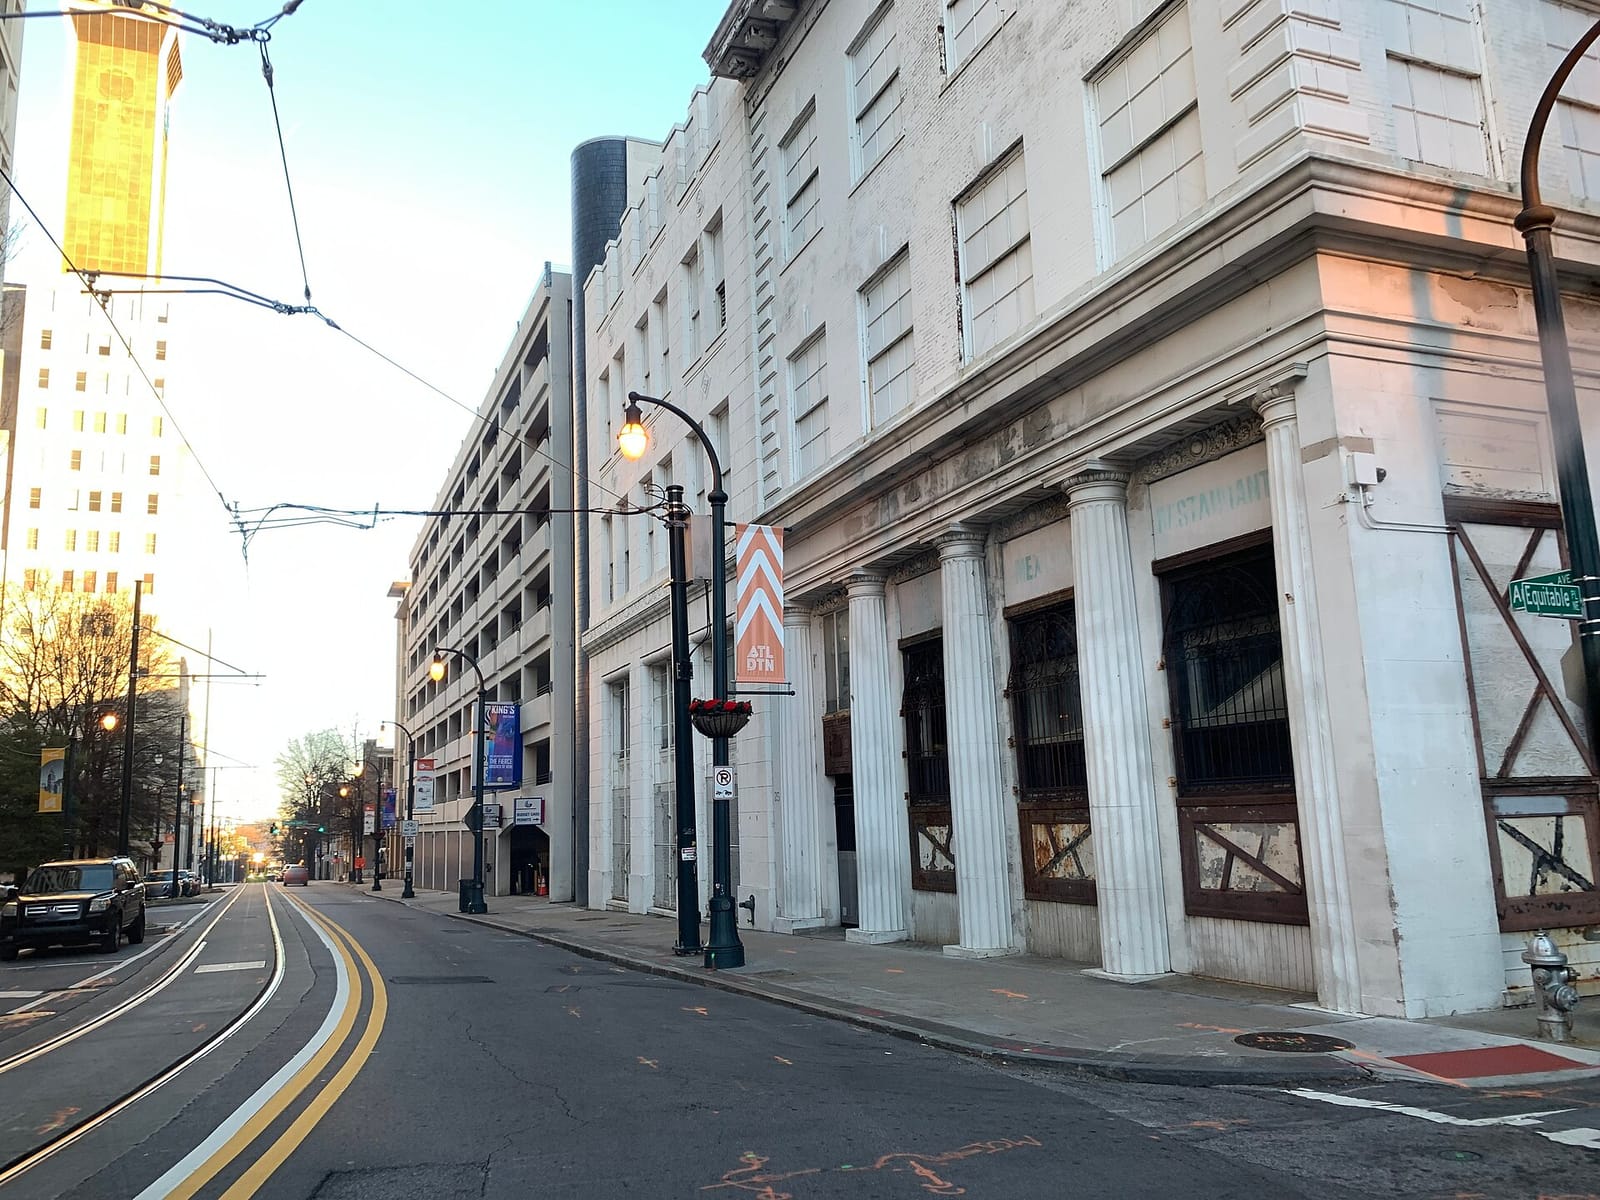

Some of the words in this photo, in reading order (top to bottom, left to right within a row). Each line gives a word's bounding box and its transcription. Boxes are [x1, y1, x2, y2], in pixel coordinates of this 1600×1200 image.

[1557, 574, 1572, 584] AVE
[1525, 585, 1570, 611] Equitable
[747, 645, 774, 658] ATL
[747, 658, 775, 672] DTN
[491, 704, 515, 714] KING'S
